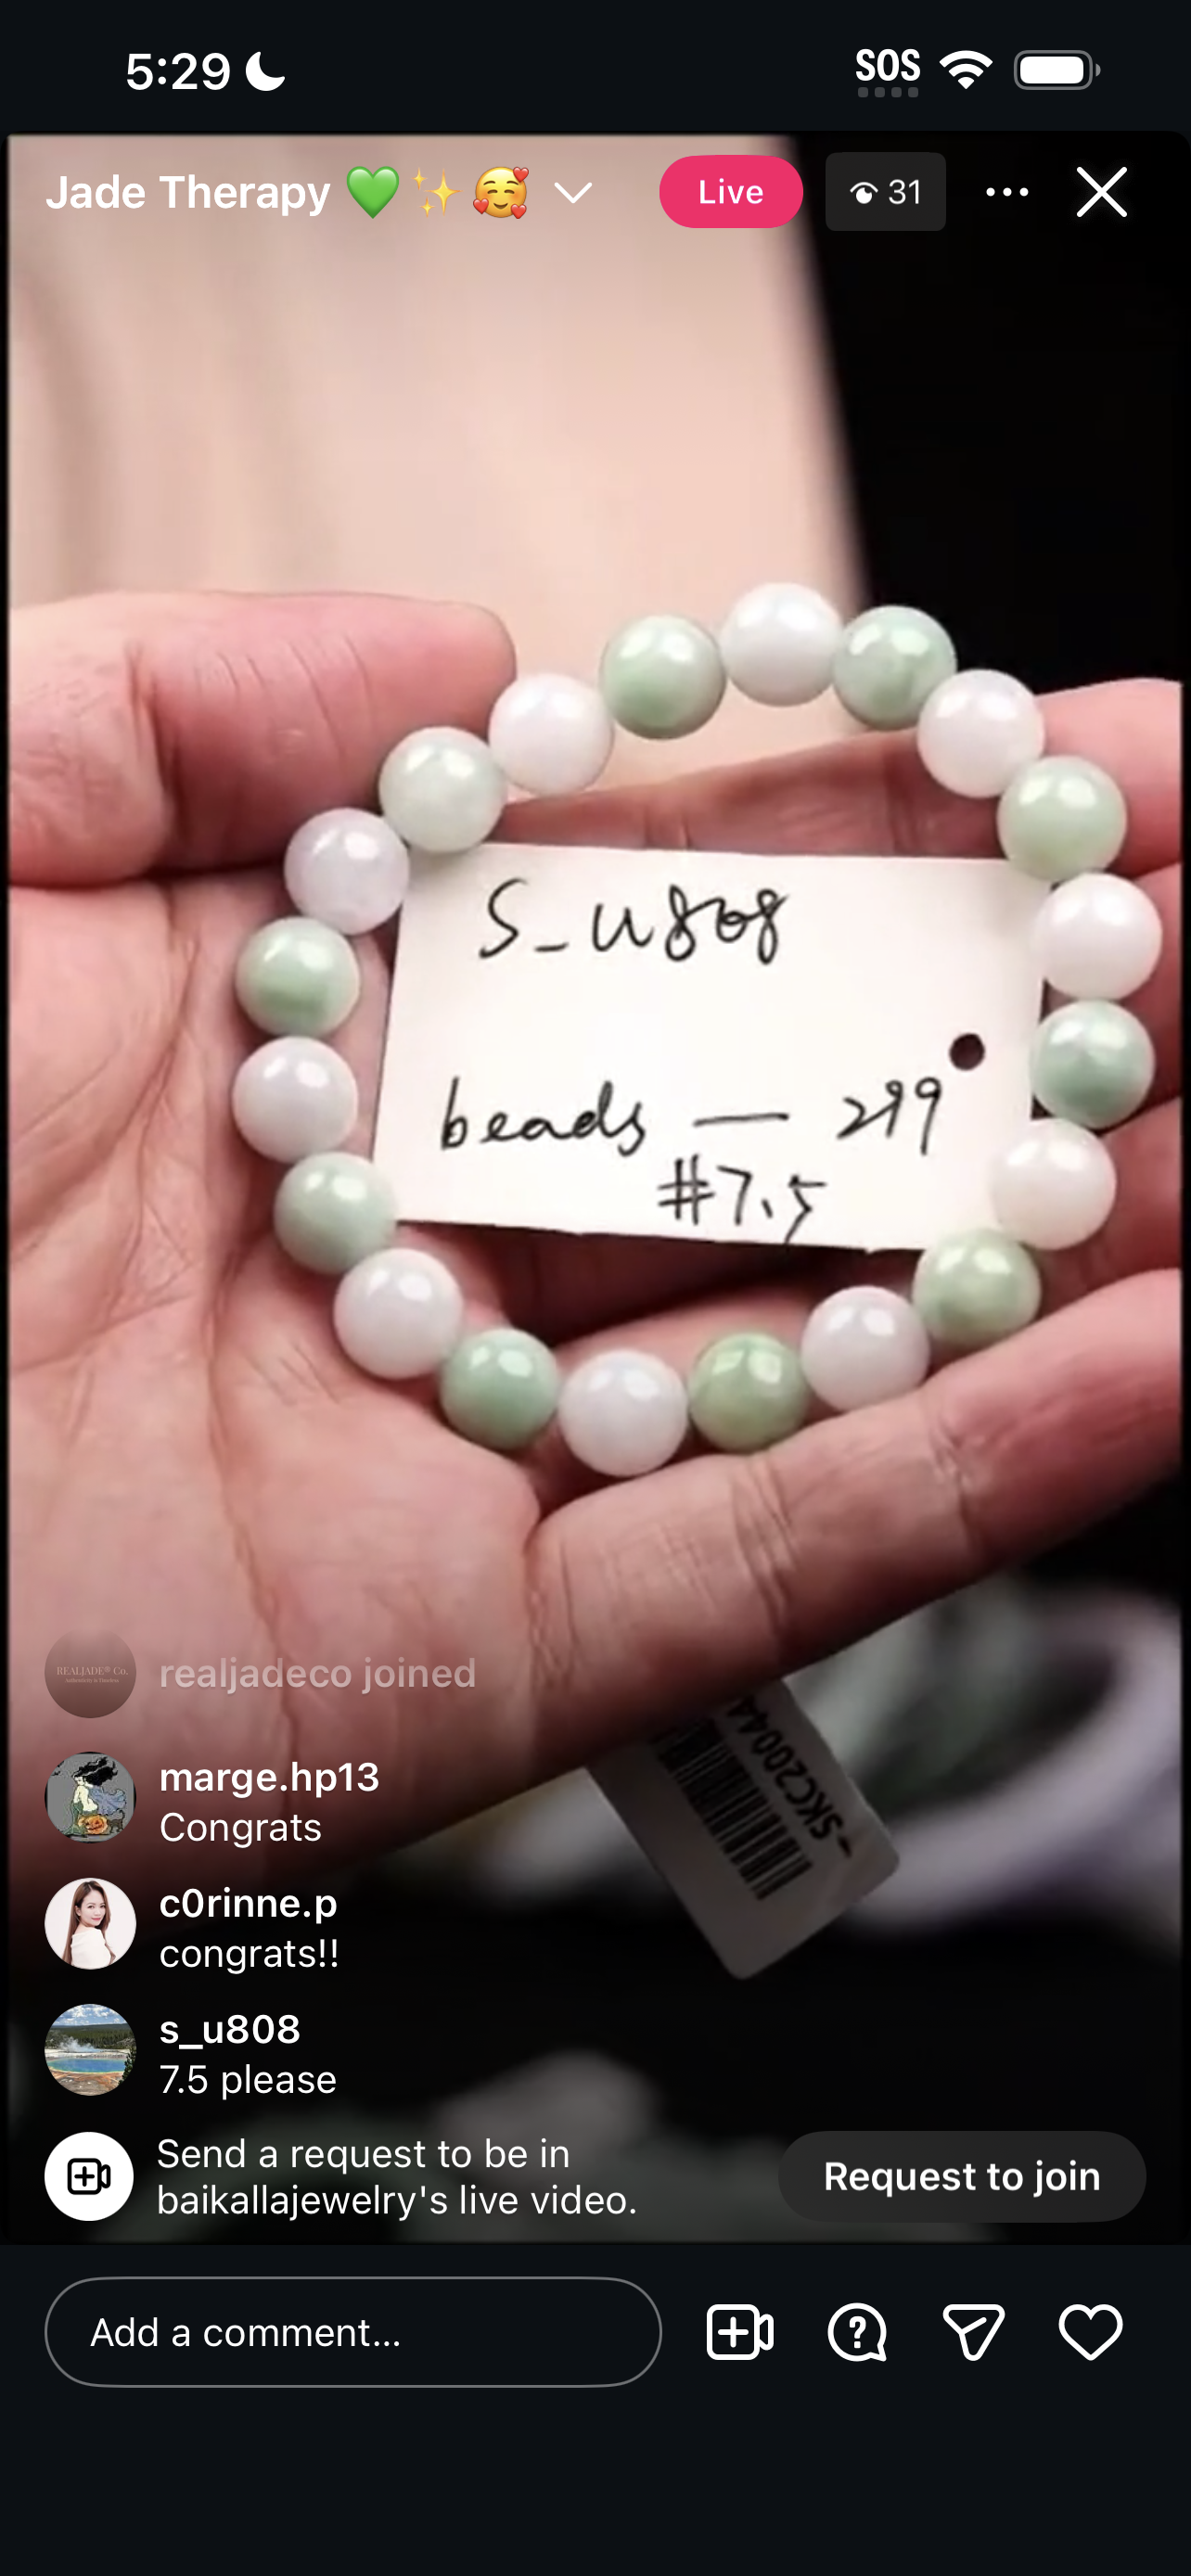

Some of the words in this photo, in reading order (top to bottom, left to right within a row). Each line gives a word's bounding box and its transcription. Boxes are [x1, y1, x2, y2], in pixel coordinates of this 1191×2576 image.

[441, 1077, 647, 1155] beads
[837, 1077, 942, 1156] 299
[658, 1154, 827, 1244] #7.5
